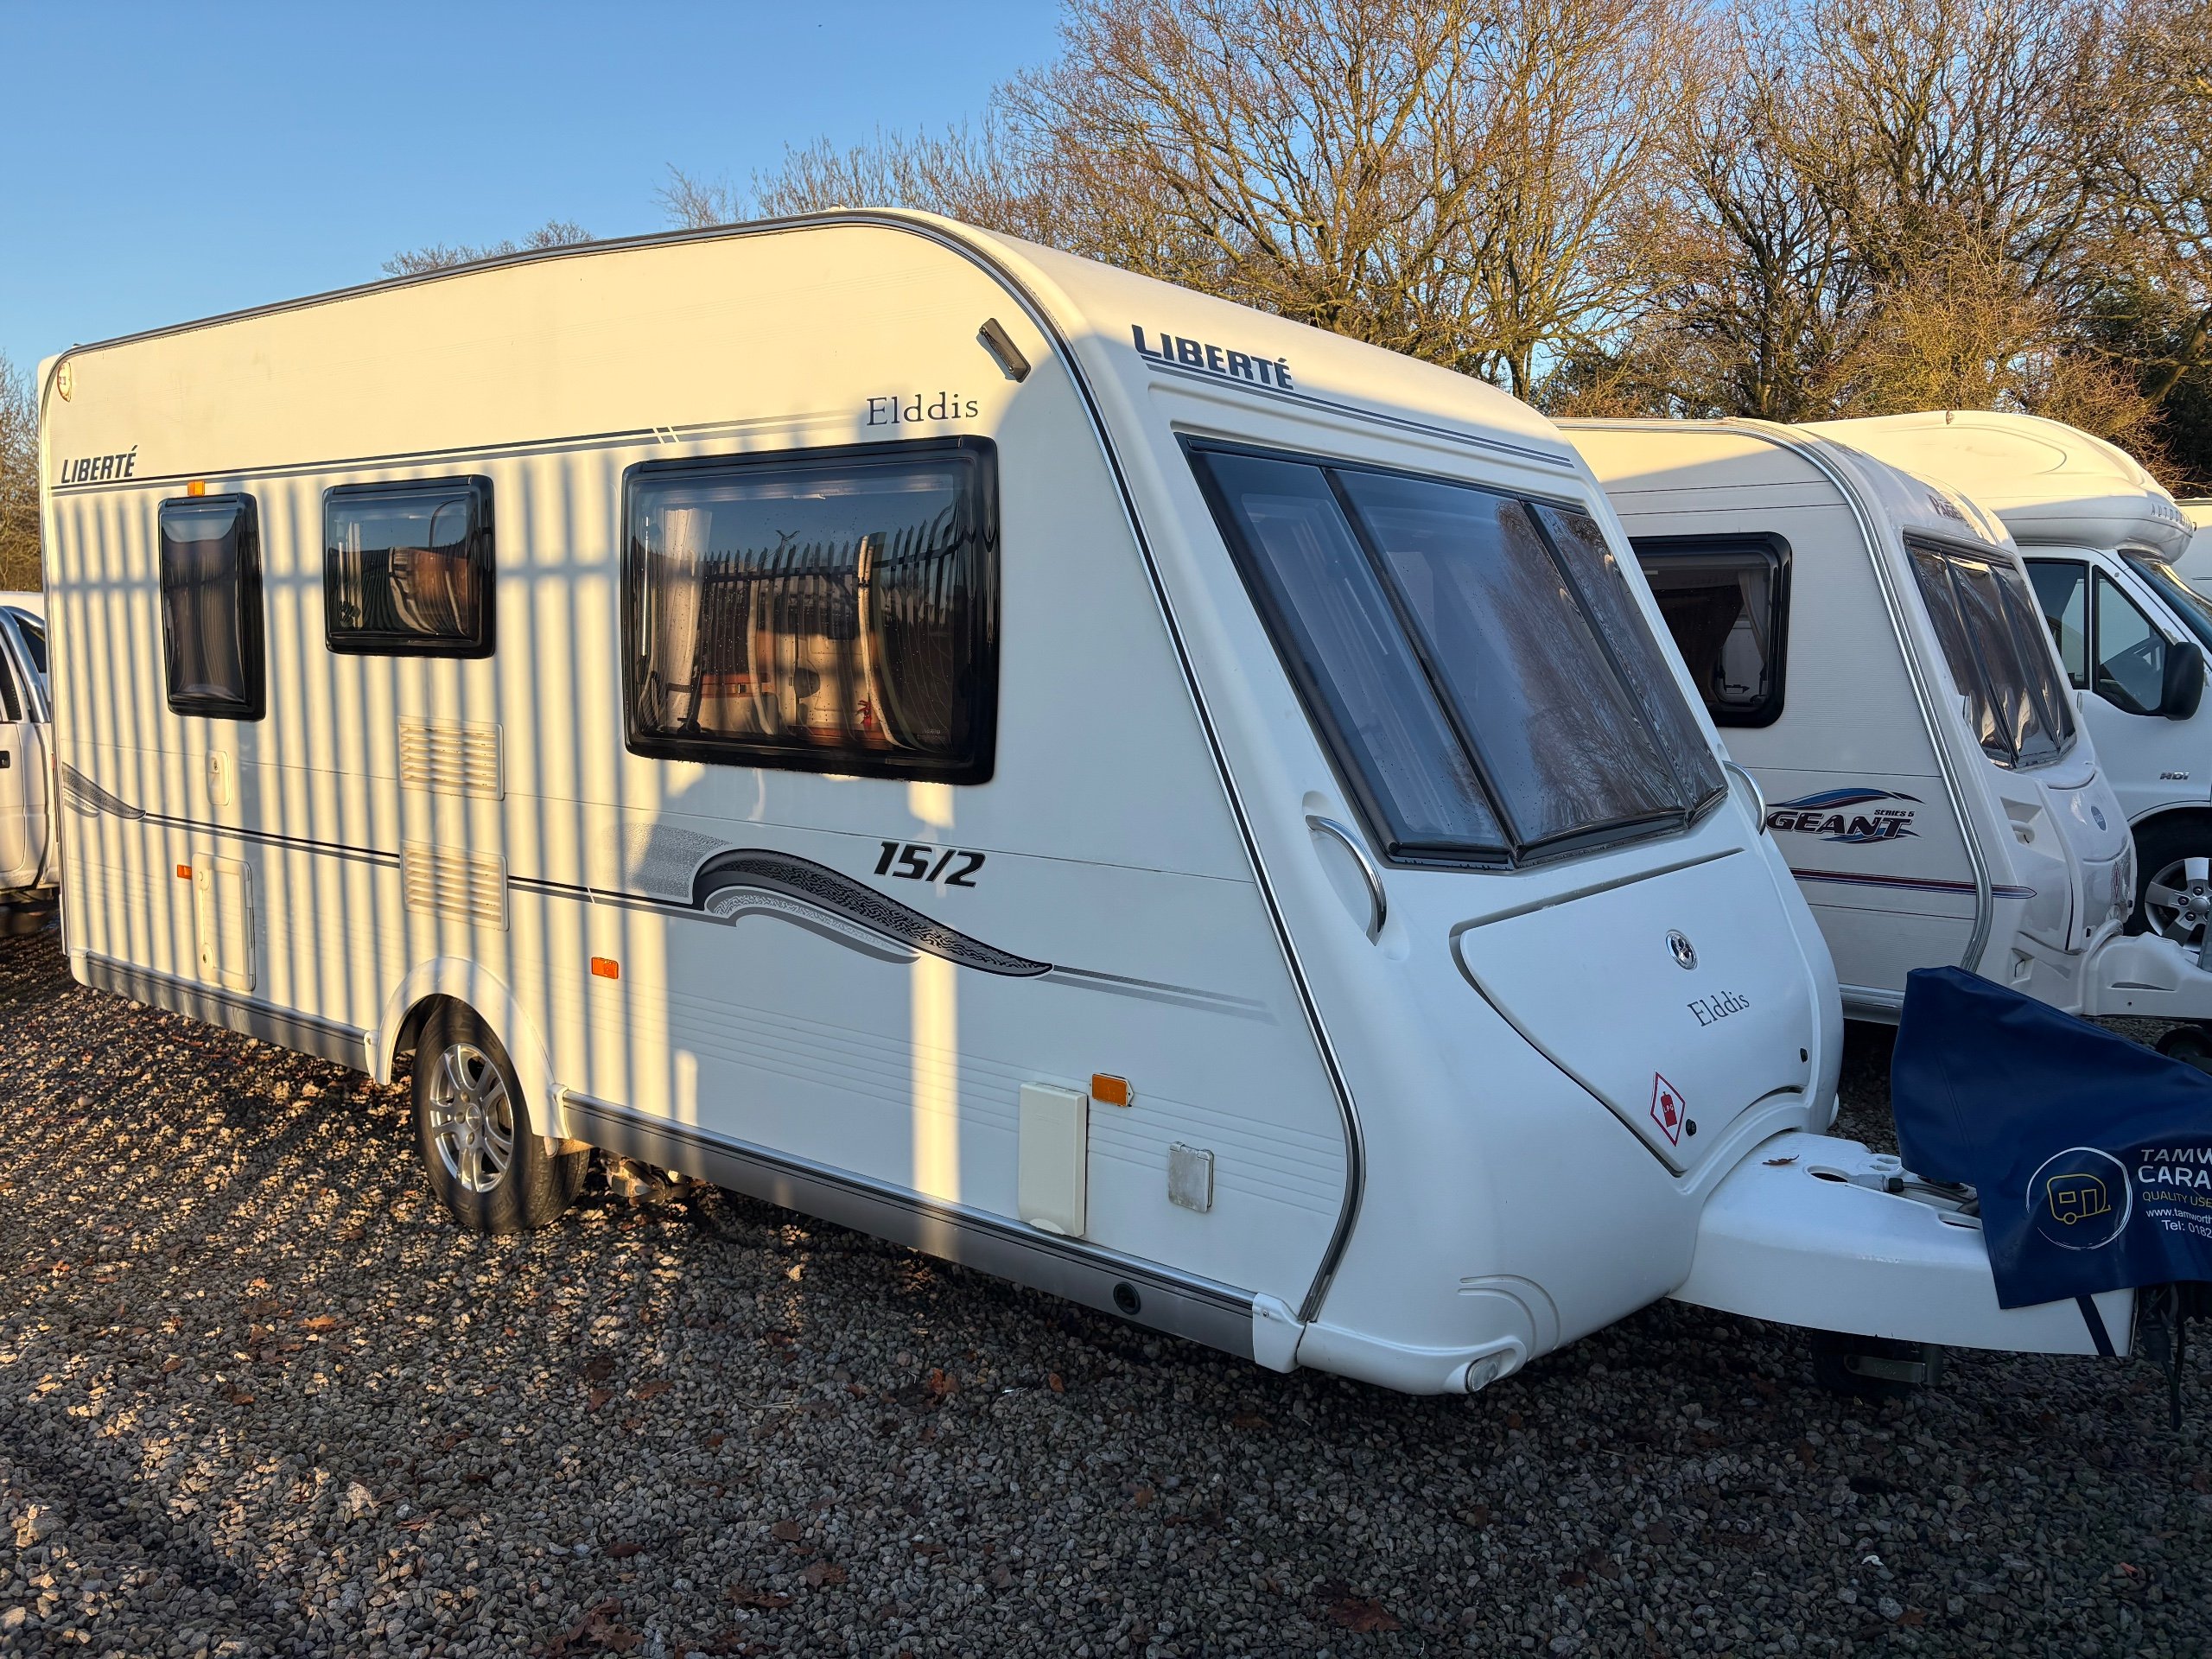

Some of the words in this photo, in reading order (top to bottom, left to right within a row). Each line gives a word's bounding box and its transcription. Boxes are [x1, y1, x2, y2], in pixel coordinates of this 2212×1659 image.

[1131, 324, 1294, 391] LIBERTÉ
[867, 391, 979, 426] Elddis
[60, 445, 138, 484] LIBERTÉ
[1765, 810, 1911, 839] GEANT
[1873, 809, 1906, 817] SERIES
[873, 841, 987, 887] 15/2
[1687, 990, 1750, 1027] Elddis
[1662, 1103, 1674, 1113] LPG
[2138, 1166, 2212, 1190] CARA
[2143, 1191, 2188, 1204] QUALITY
[2161, 1219, 2185, 1231] Tel:
